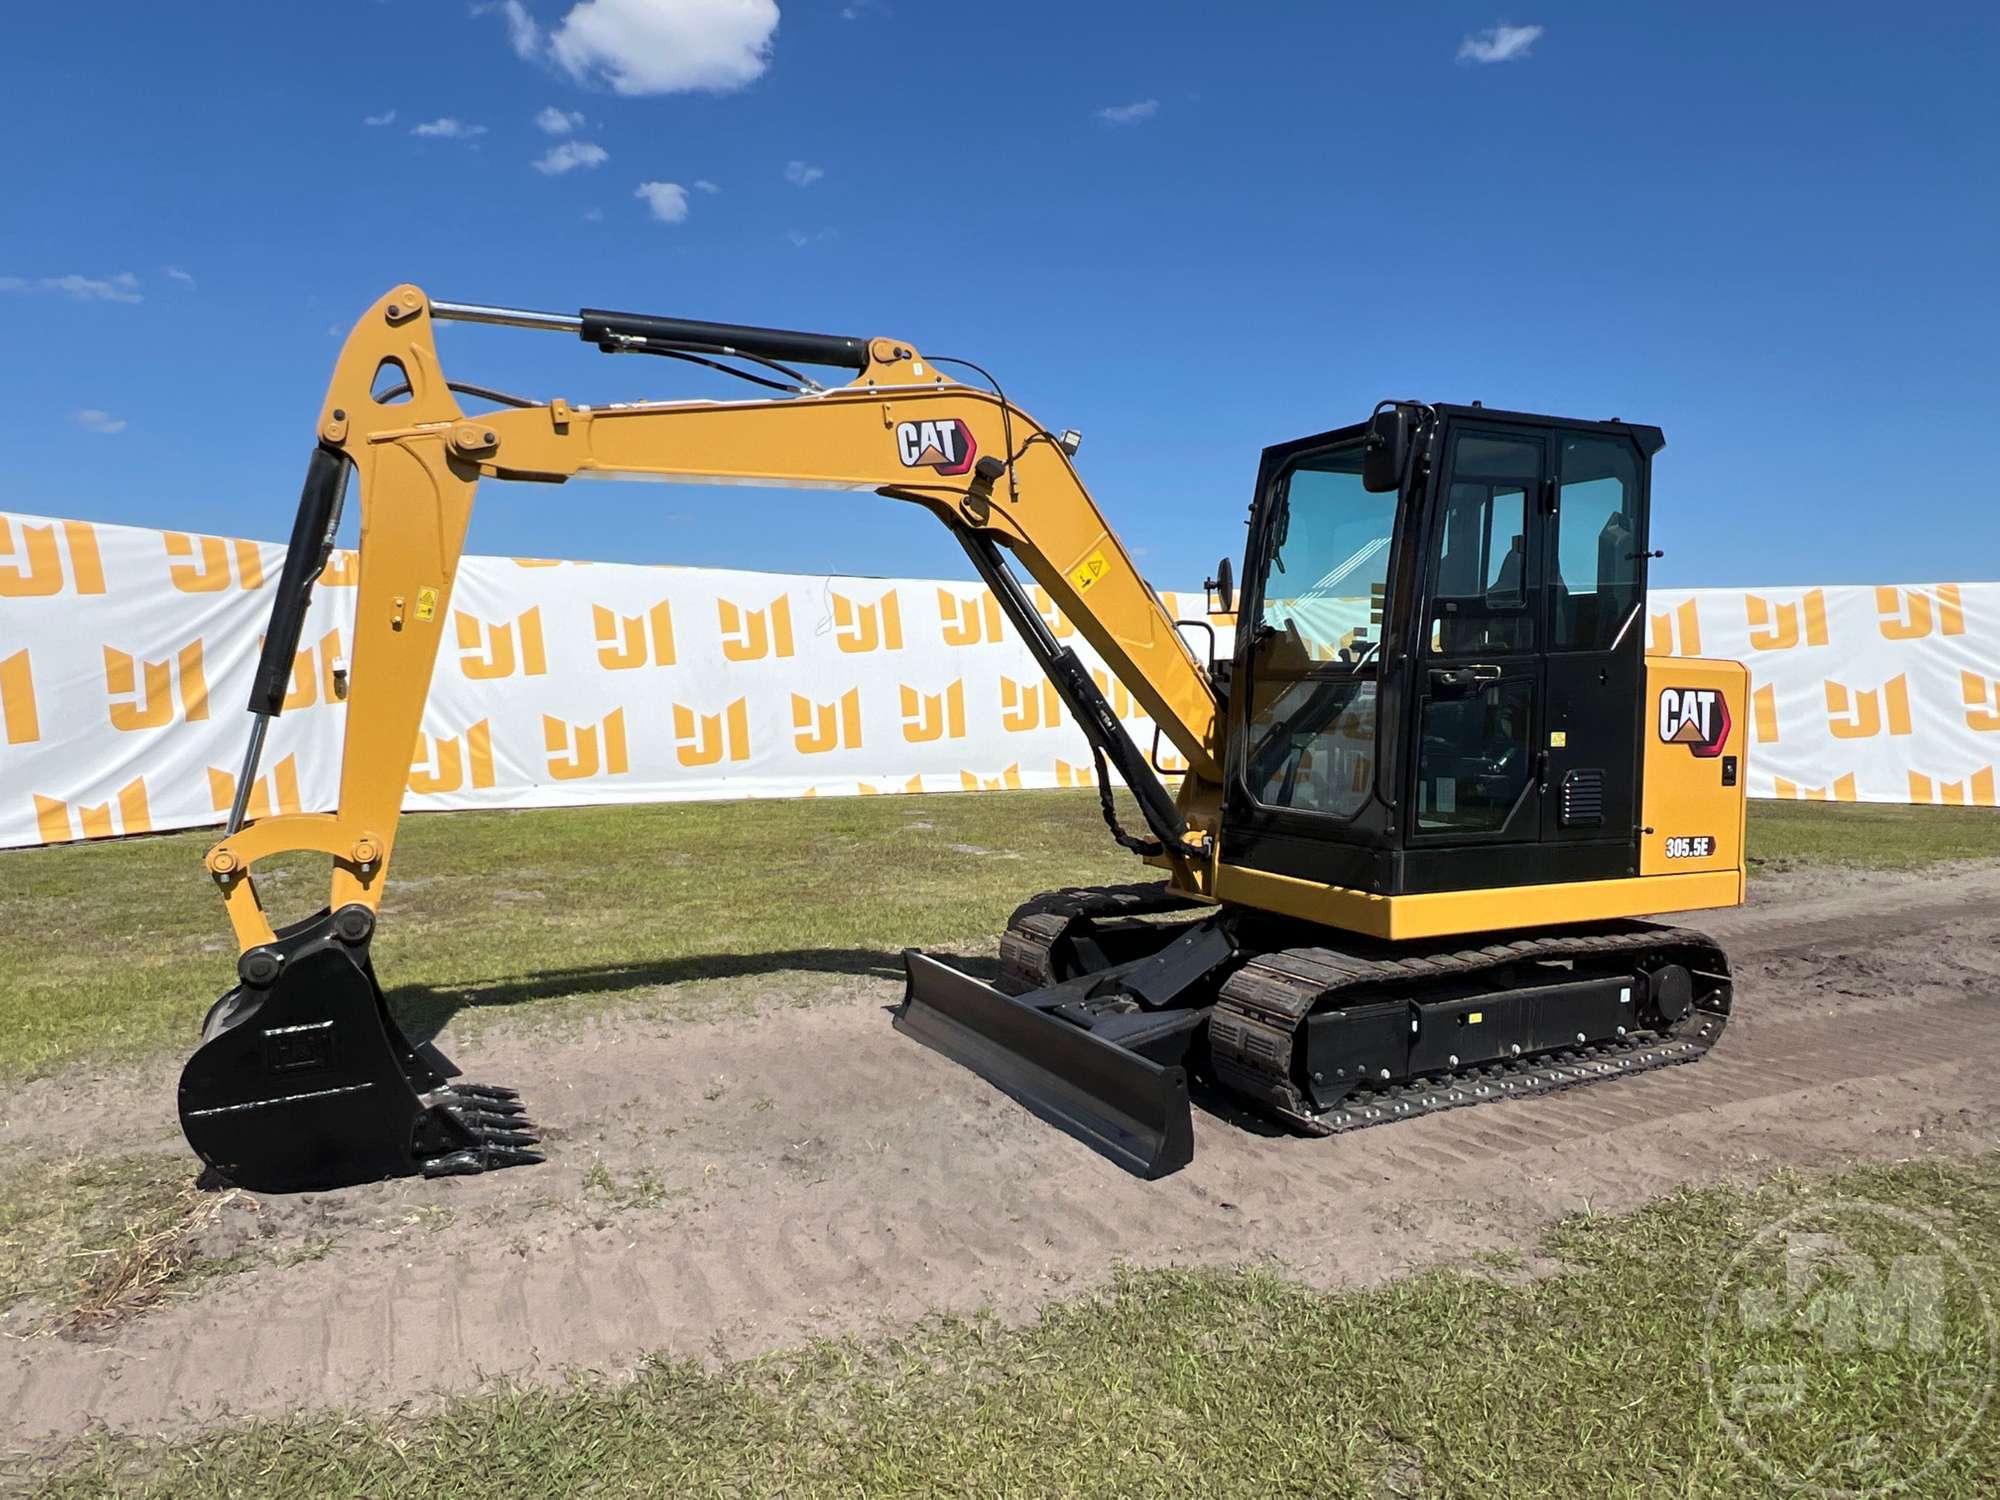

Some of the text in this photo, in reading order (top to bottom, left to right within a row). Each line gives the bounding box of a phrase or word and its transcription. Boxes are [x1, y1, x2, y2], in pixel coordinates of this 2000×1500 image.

[897, 420, 956, 466] CAT
[1660, 689, 1716, 742] CAT
[1666, 837, 1709, 858] 305.5E
